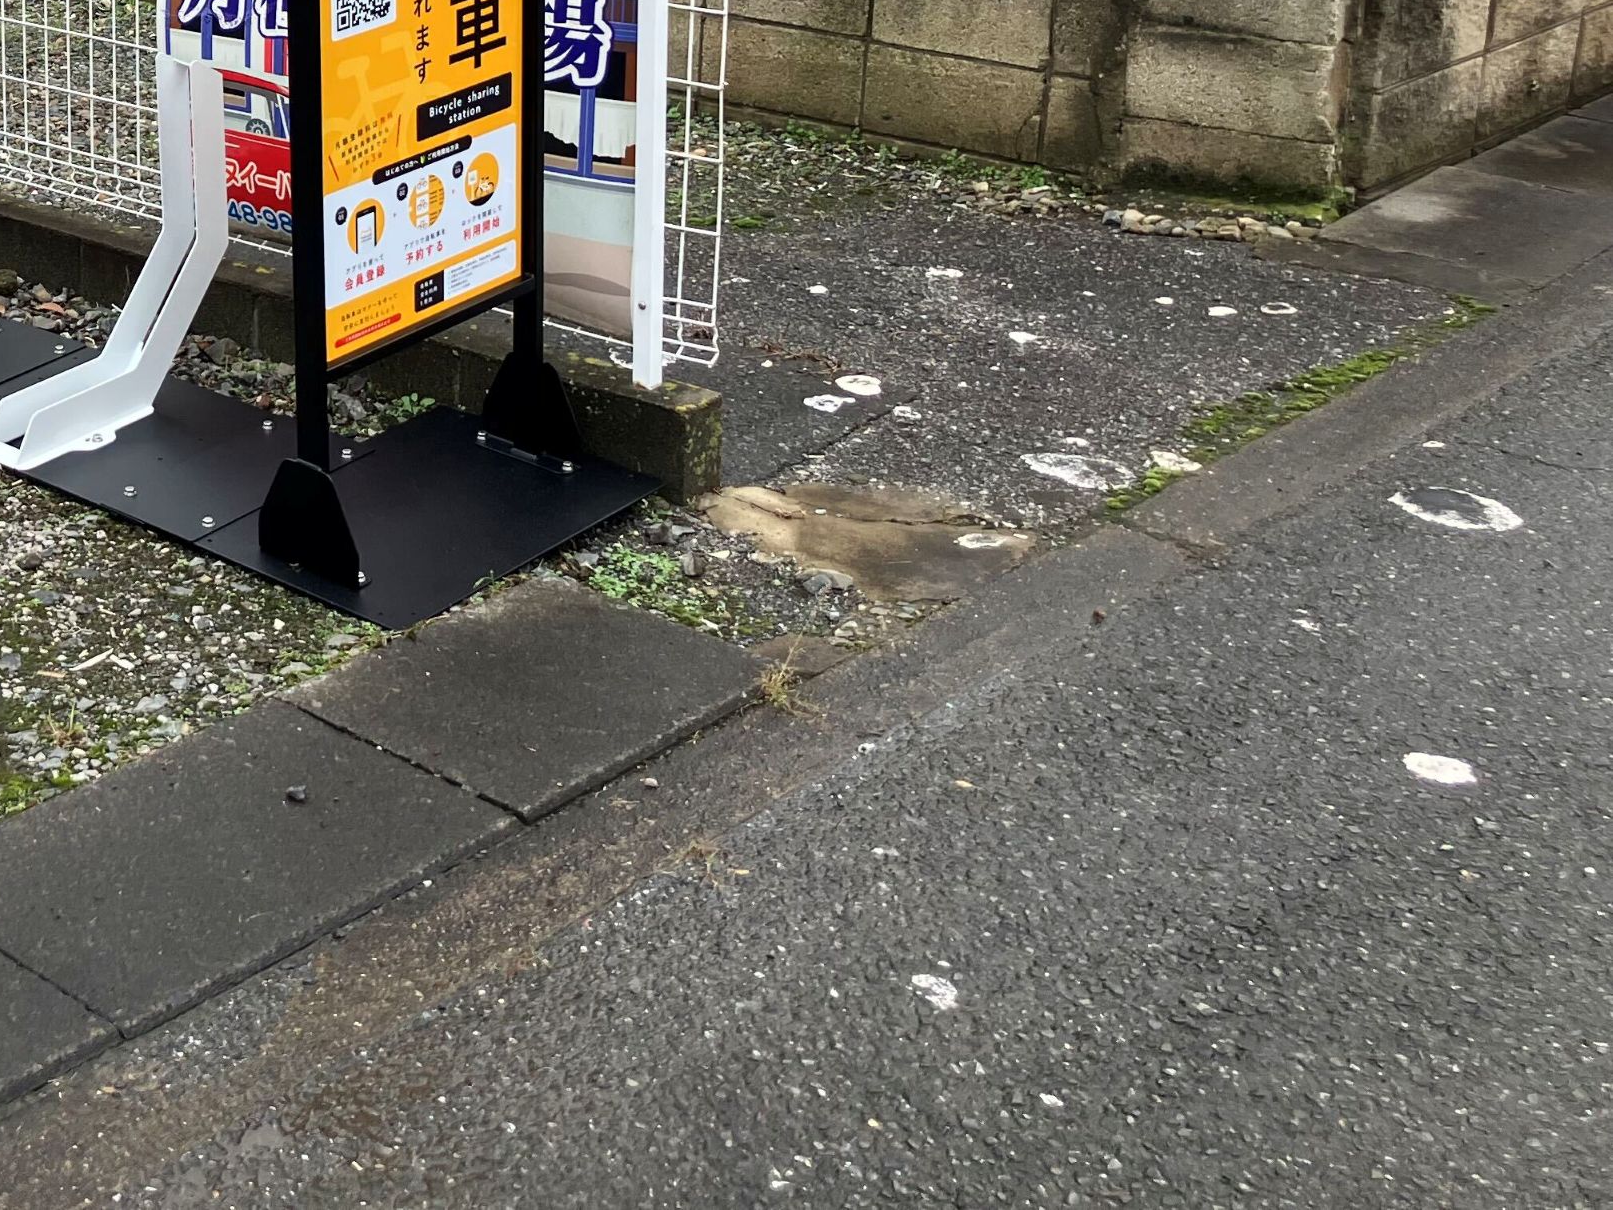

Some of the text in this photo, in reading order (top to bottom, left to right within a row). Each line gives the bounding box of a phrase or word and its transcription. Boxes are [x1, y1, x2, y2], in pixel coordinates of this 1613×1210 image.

[429, 85, 500, 118] Bicycle sharing
[448, 105, 481, 124] station
[406, 240, 443, 265] 予約する
[344, 264, 386, 291] 会員登録
